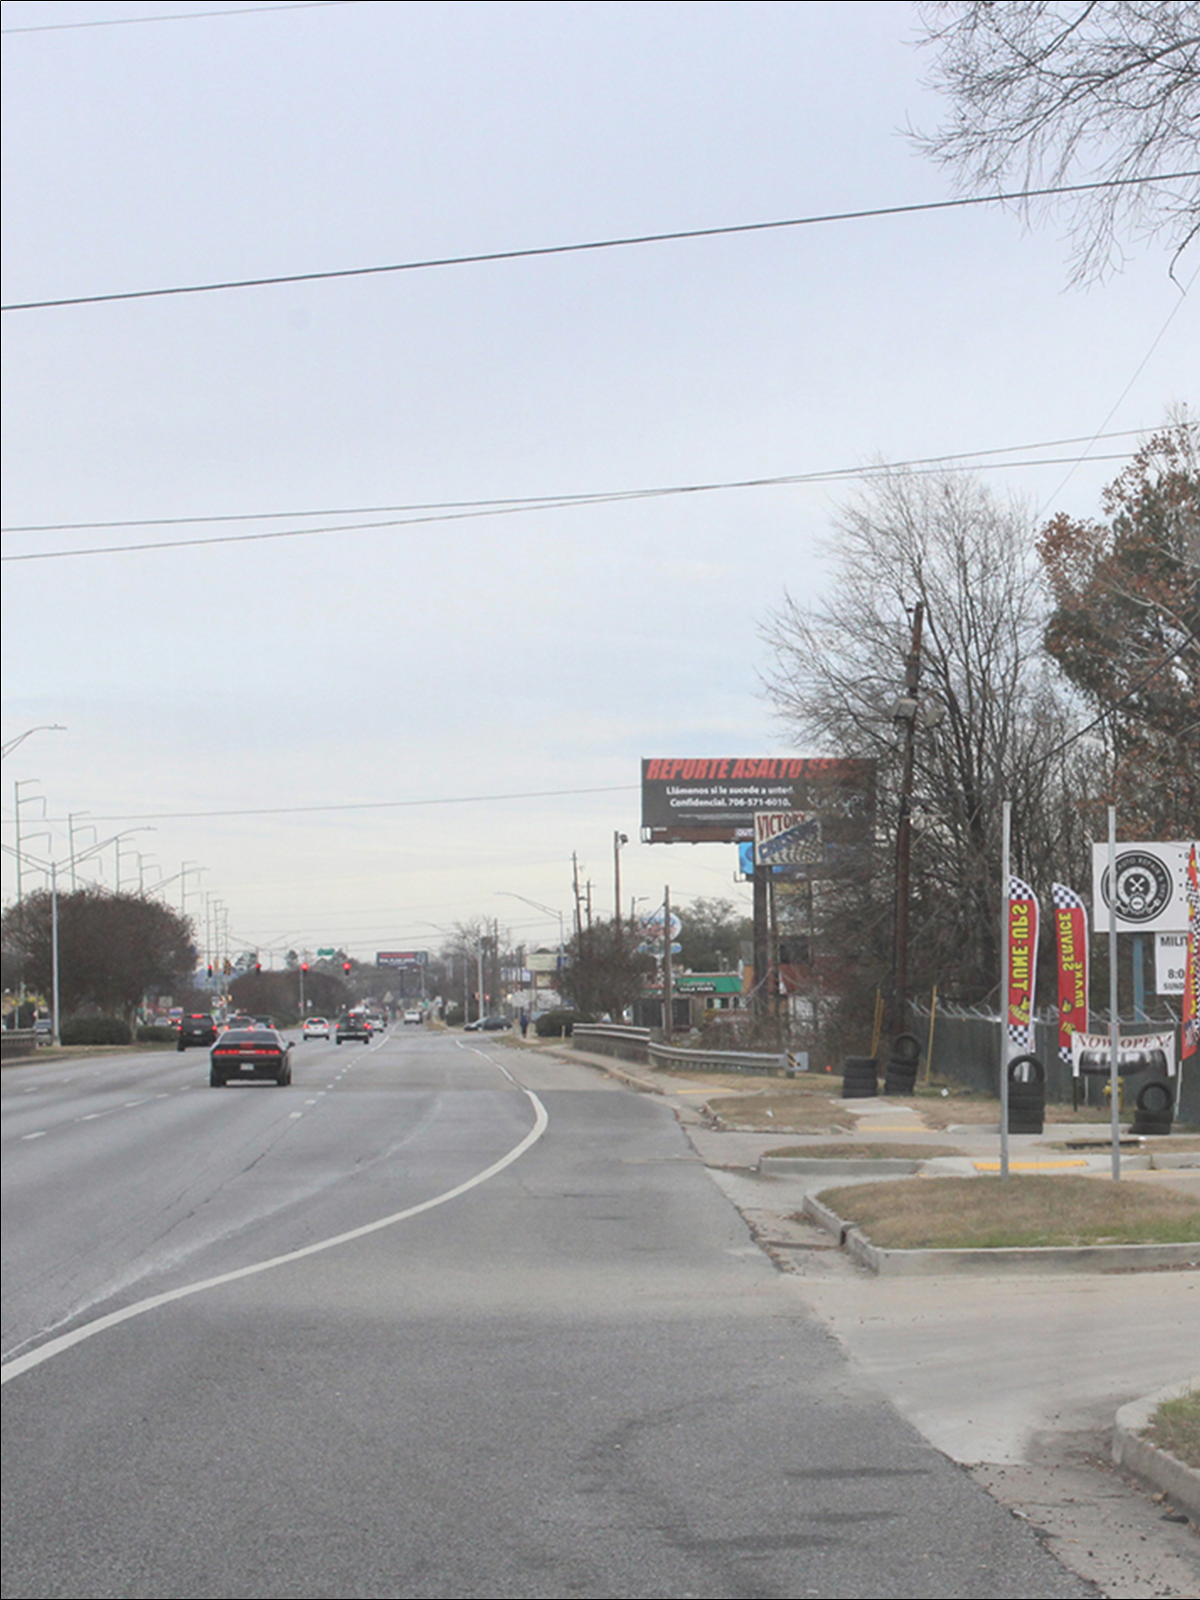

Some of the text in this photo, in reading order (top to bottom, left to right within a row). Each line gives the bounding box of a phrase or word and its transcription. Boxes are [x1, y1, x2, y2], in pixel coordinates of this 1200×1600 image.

[646, 759, 731, 780] REPORTE
[731, 759, 804, 779] ASALTO
[666, 786, 709, 795] Llámenos
[711, 786, 718, 794] si
[719, 786, 727, 794] le
[729, 785, 759, 794] sucede
[670, 798, 727, 807] Confidencial.
[1168, 969, 1187, 979] 8:0
